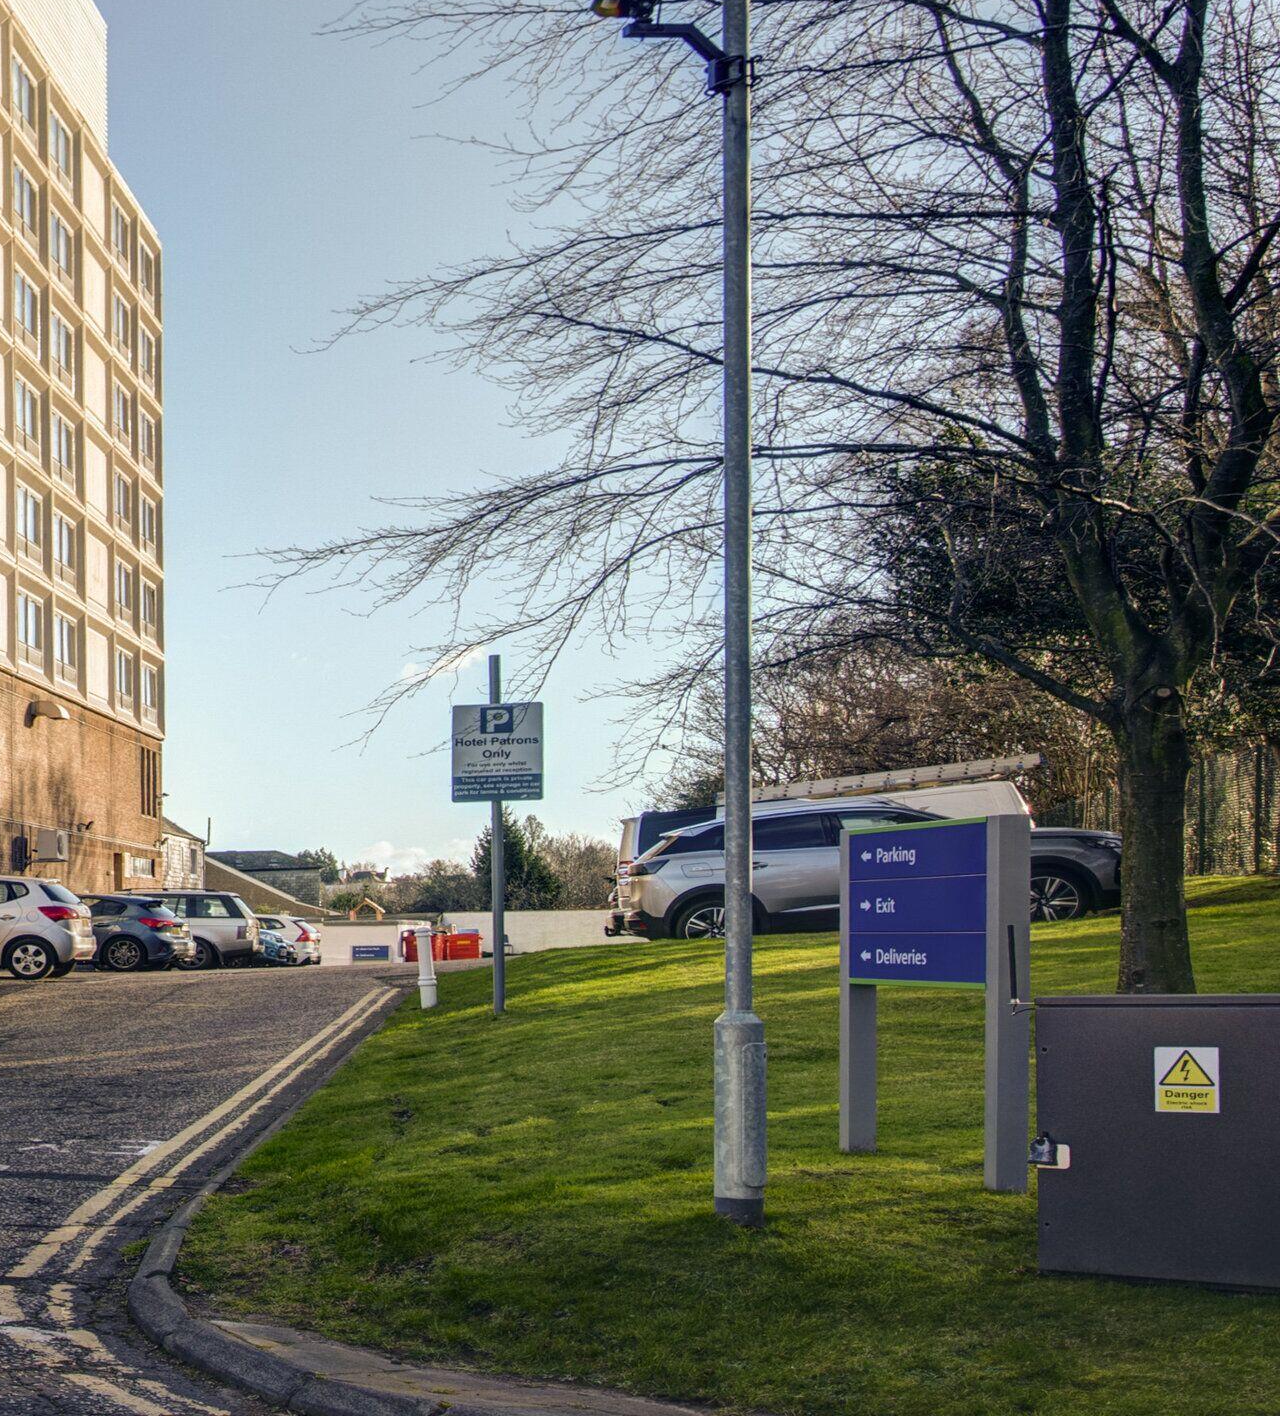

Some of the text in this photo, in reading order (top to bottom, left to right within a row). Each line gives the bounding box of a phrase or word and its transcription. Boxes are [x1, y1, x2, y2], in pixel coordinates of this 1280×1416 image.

[486, 709, 510, 733] P
[455, 736, 539, 747] Hotel Patrons
[482, 749, 511, 759] Only
[876, 846, 916, 866] Parking
[876, 897, 896, 913] Exit
[876, 948, 927, 965] Deliveries
[1165, 1089, 1209, 1100] Danger
